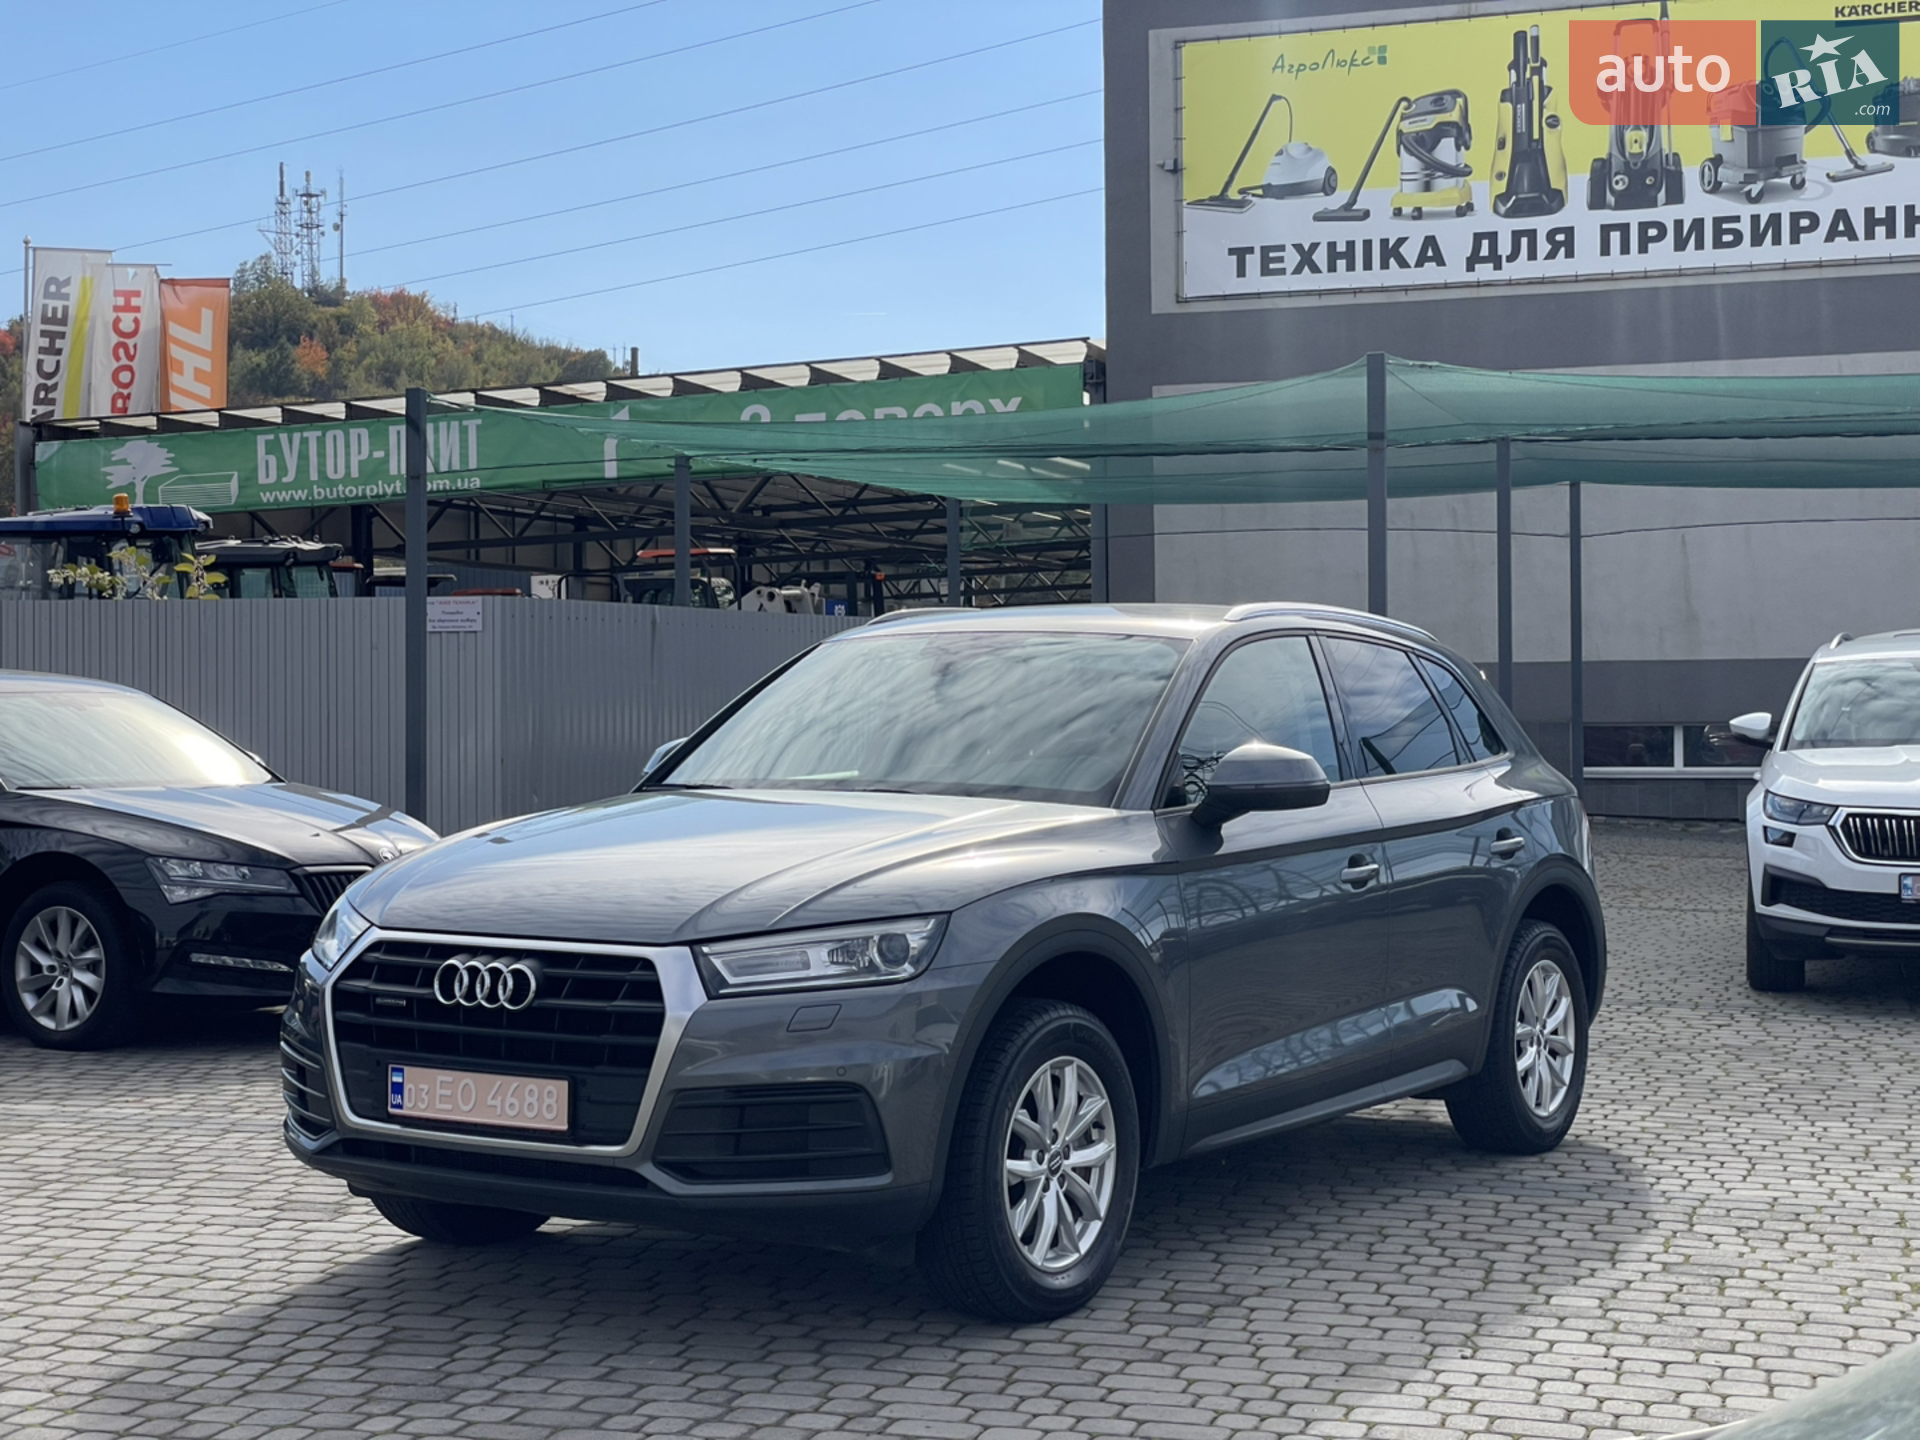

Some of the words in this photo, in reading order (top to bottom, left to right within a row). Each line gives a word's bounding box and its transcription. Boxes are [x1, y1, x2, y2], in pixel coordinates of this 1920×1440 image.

[1834, 1, 1920, 18] KÄRCHER
[1271, 48, 1374, 80] АгроЛюкс
[1227, 235, 1447, 278] ТЕХНІКА
[1465, 226, 1576, 273] ДЛЯ
[391, 1093, 403, 1106] UA
[406, 1083, 430, 1110] 03
[435, 1076, 477, 1112] EO
[487, 1080, 559, 1121] 4688
